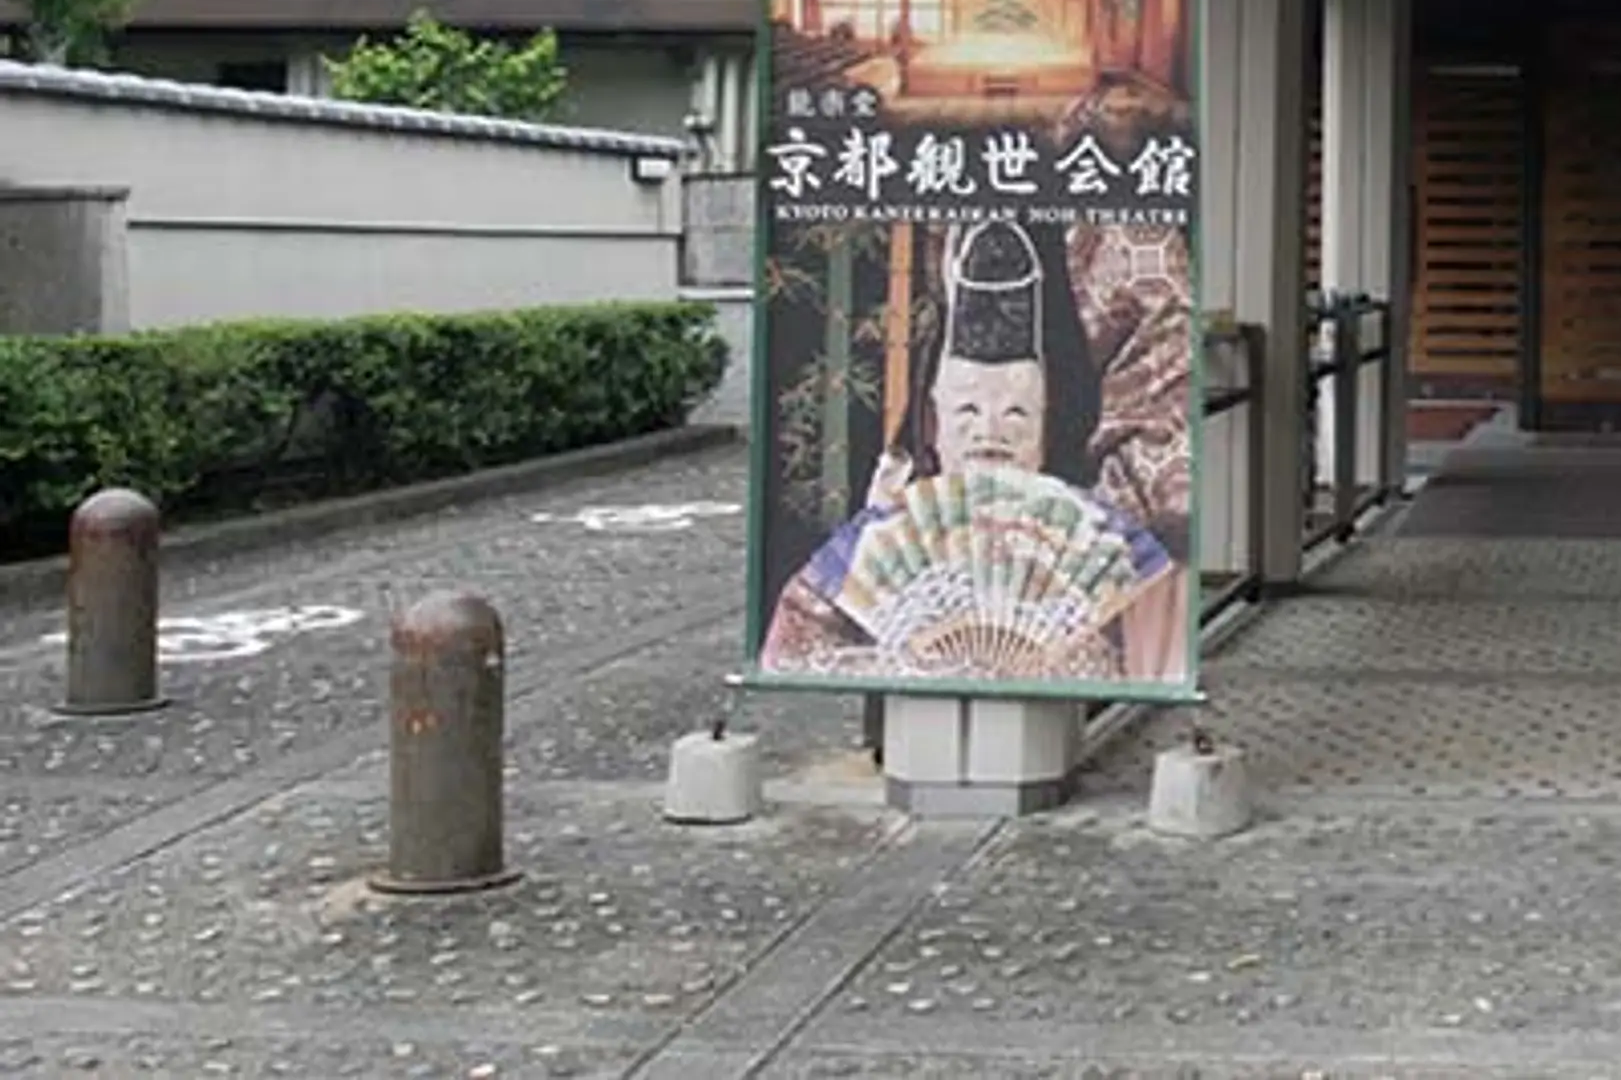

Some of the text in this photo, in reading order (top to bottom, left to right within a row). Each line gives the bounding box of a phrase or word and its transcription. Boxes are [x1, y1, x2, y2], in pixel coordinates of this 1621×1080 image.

[766, 127, 1196, 200] 京都観世会館
[776, 204, 849, 221] KYOTO
[1028, 206, 1077, 222] NOH
